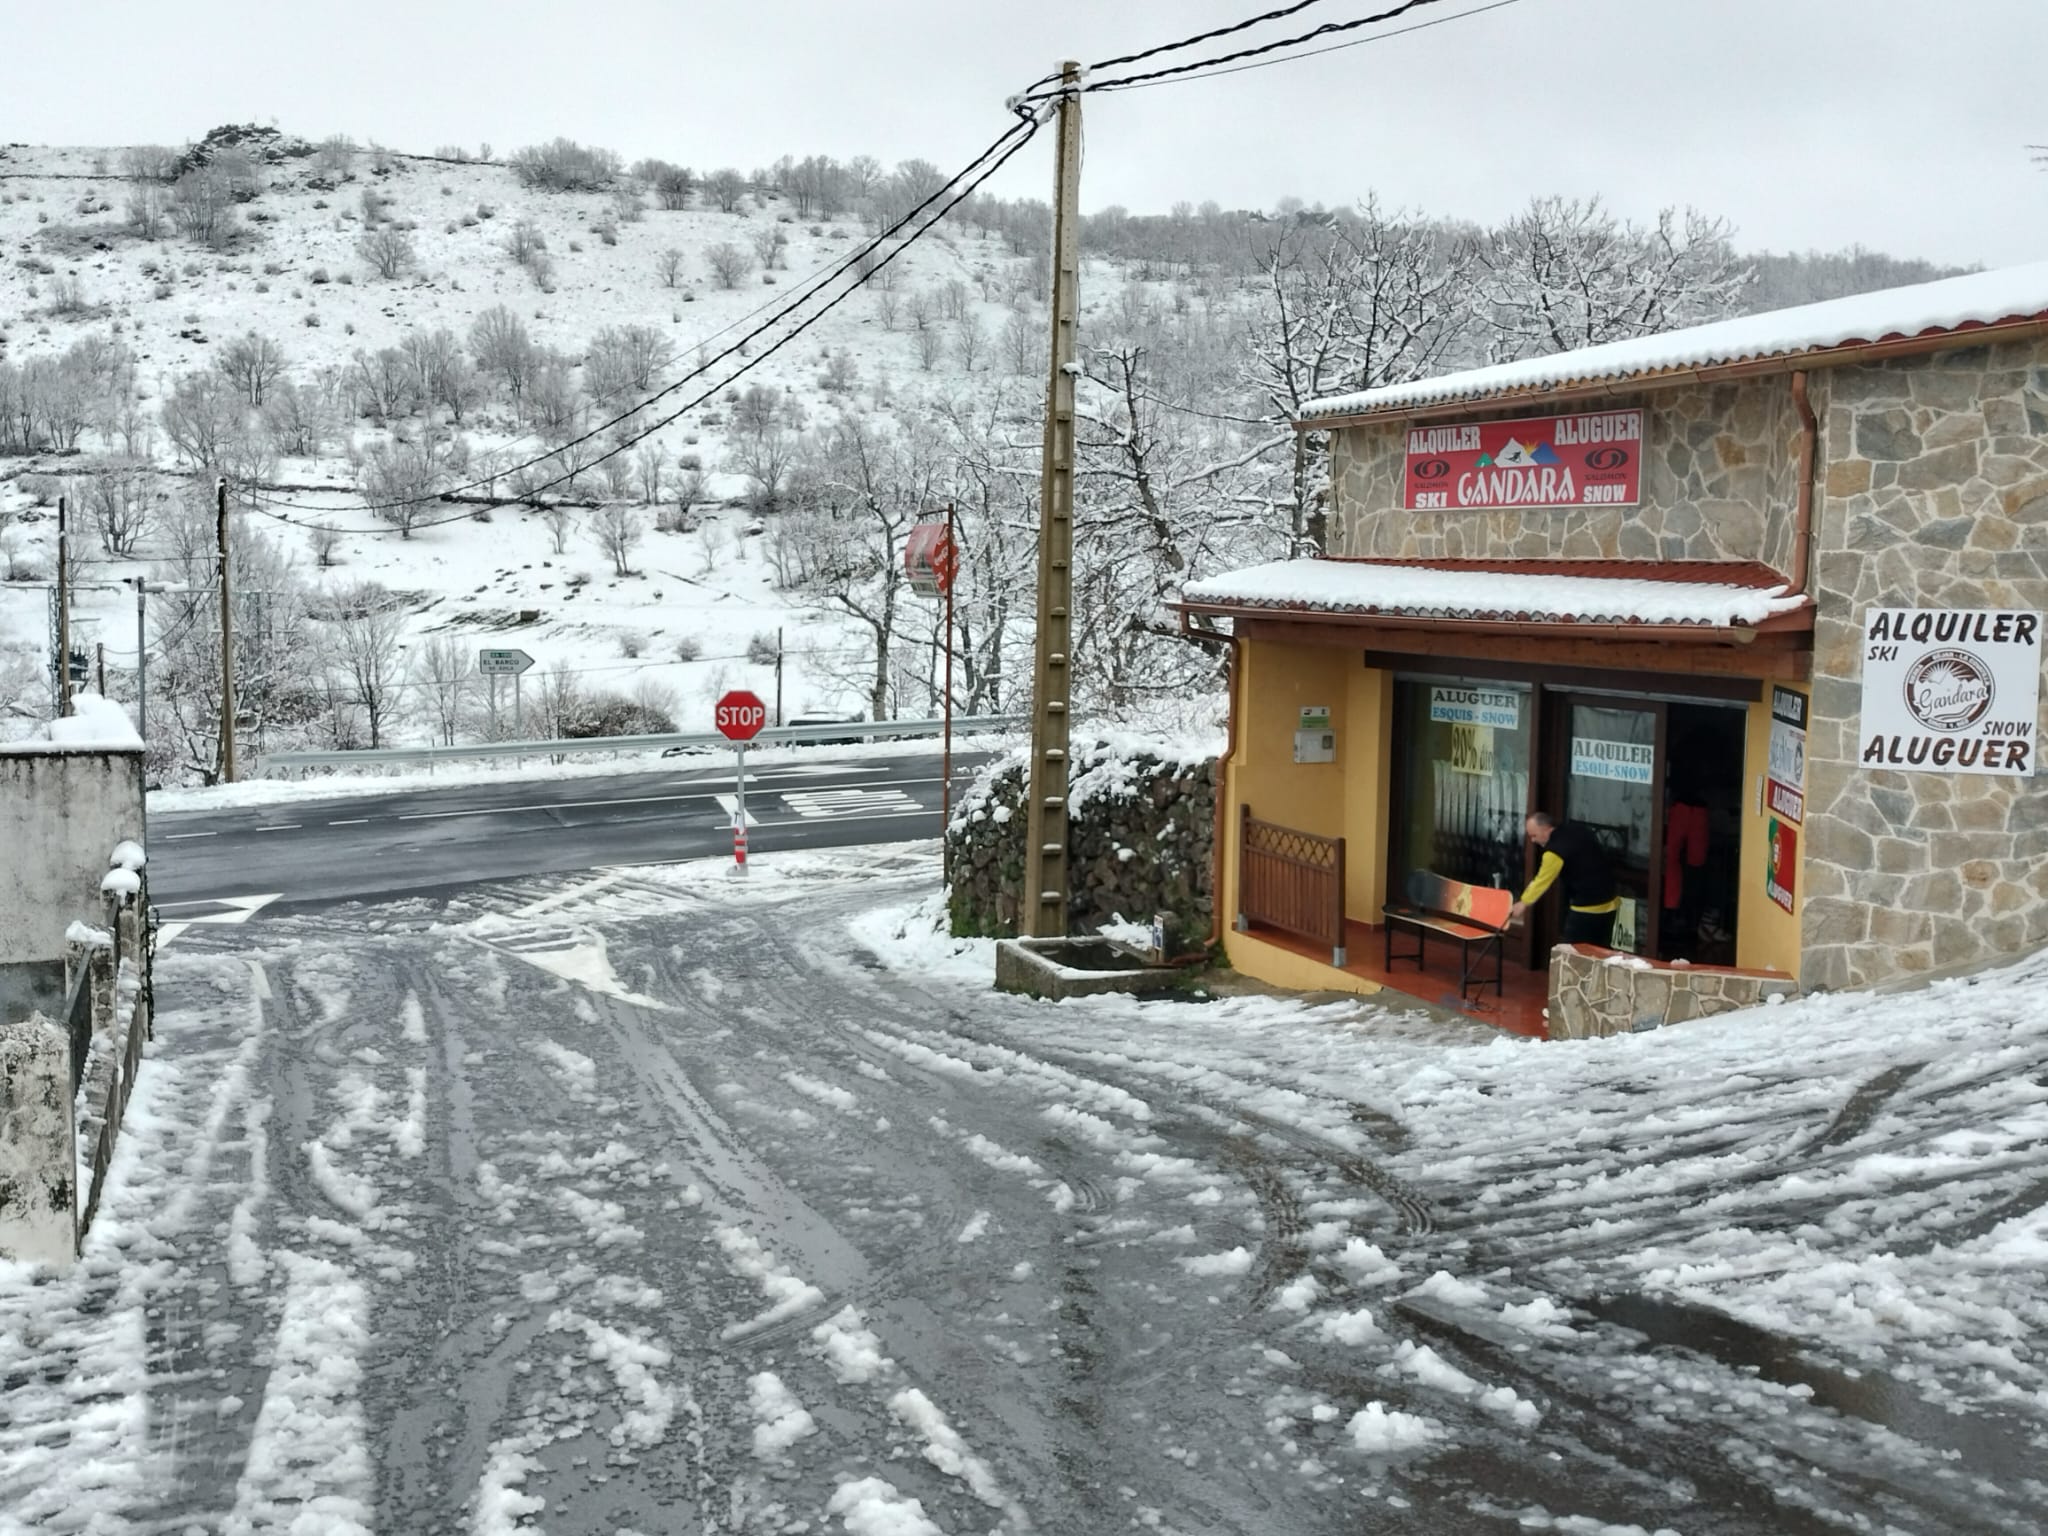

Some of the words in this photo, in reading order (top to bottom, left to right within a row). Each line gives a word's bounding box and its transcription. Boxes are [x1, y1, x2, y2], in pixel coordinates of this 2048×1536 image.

[1554, 412, 1640, 446] ALUGUER
[1409, 426, 1481, 456] ALQUILER
[1457, 466, 1576, 505] GANDARA
[1583, 484, 1627, 503] SNOW
[1415, 491, 1448, 508] SKI
[1868, 612, 2038, 646] ALQUILER
[1868, 646, 1899, 662] SKI
[1433, 690, 1517, 709] ALUGUER
[1916, 683, 1986, 716] Gandara
[718, 706, 764, 726] STOP
[1432, 706, 1473, 722] ESQUIS
[1481, 713, 1517, 727] SNOW
[1982, 721, 2032, 737] SNOW
[1453, 726, 1478, 770] 20%
[1574, 740, 1652, 764] ALQUILER
[1863, 735, 2030, 772] ALUGUER
[1575, 759, 1650, 782] ESQUI-SNOW
